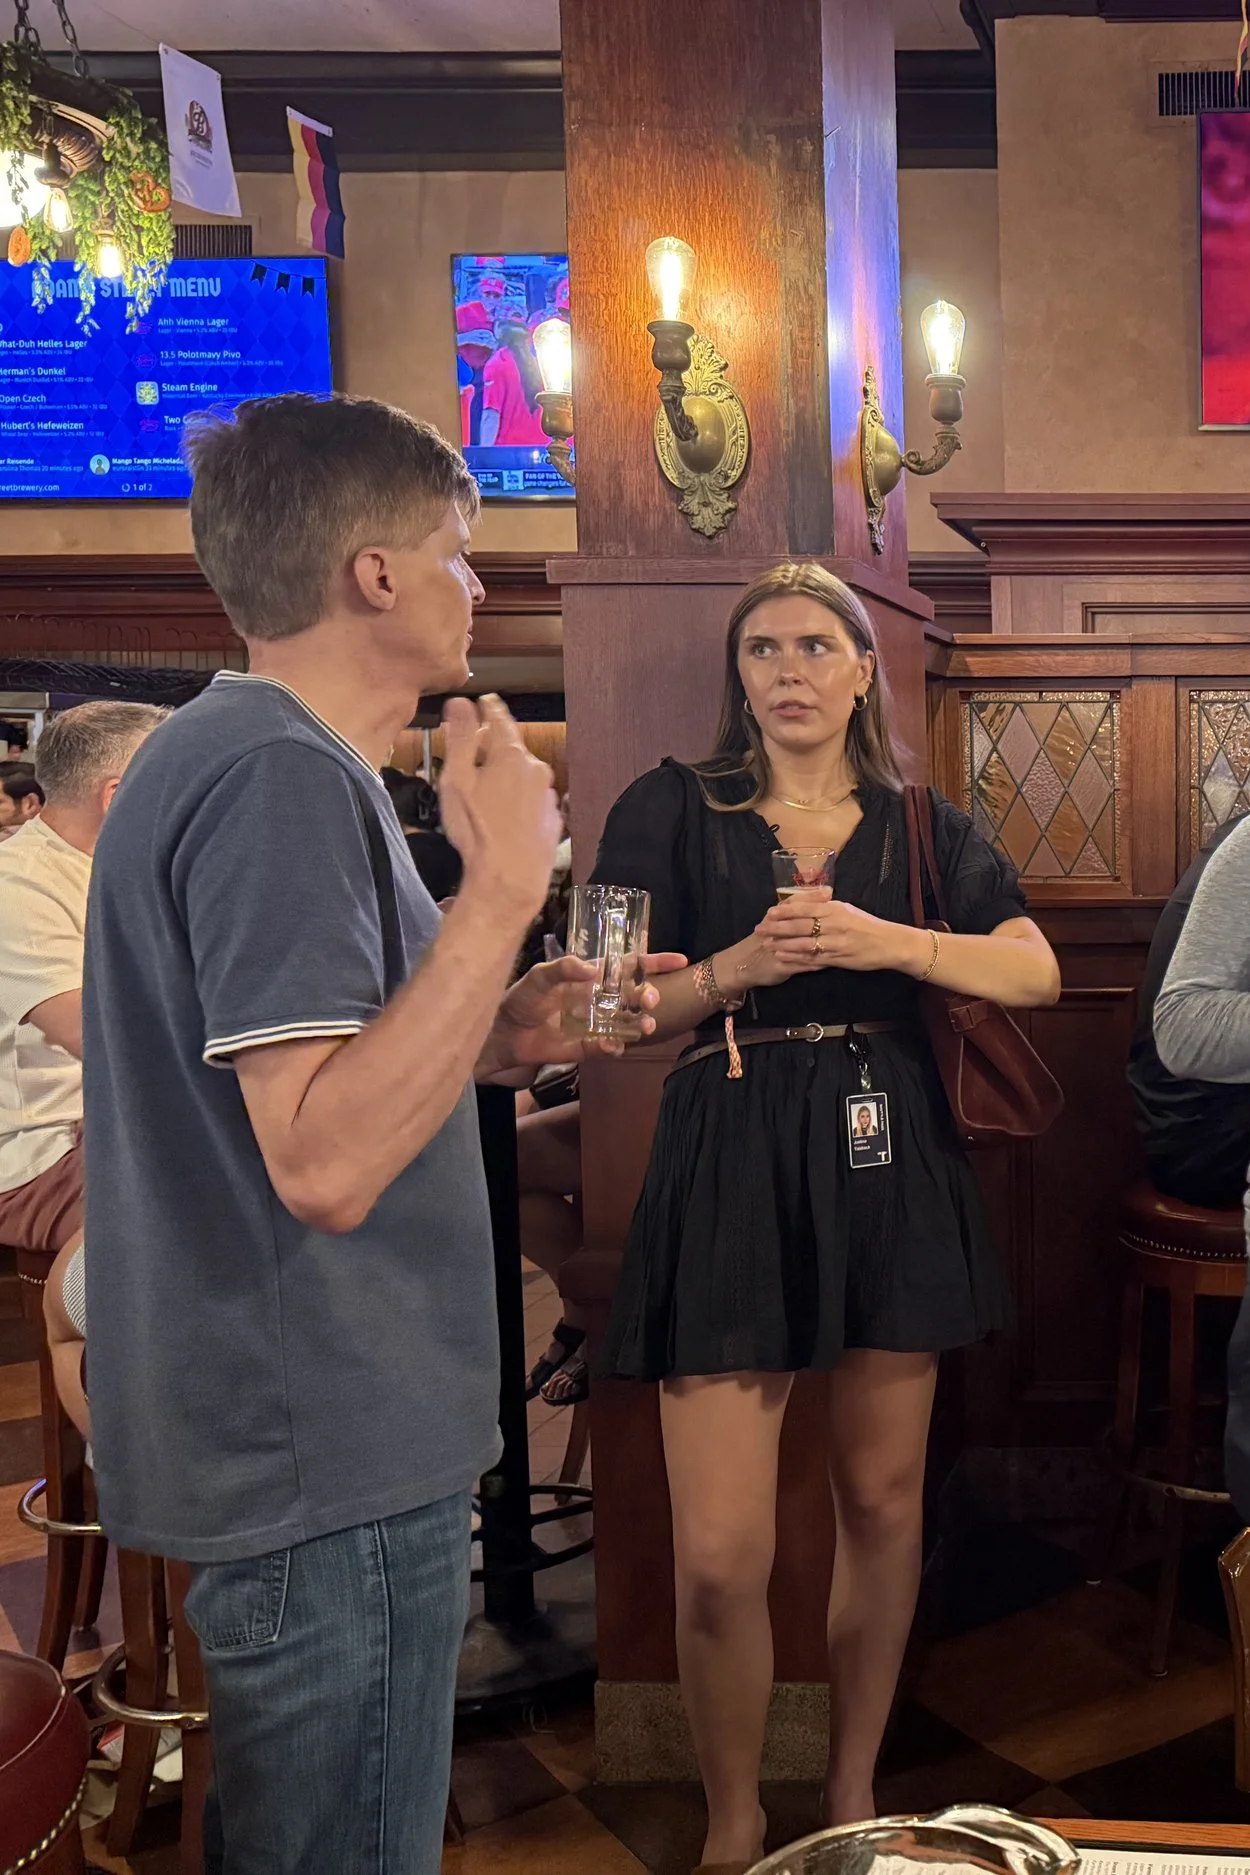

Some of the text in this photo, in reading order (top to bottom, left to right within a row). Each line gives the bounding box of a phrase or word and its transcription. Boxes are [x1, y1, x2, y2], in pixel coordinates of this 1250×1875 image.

[169, 277, 221, 297] MENU
[158, 317, 229, 328] Ahh Vienna Lager
[37, 339, 63, 348] Helles
[65, 340, 87, 349] Lager
[160, 350, 176, 359] 13.5
[223, 350, 241, 358] Pivo
[37, 367, 66, 375] Dunkel
[162, 382, 218, 393] Steam Engine
[23, 394, 46, 403] Czech
[164, 415, 181, 424] Two
[1, 421, 84, 430] Hubert's Hefeweizen
